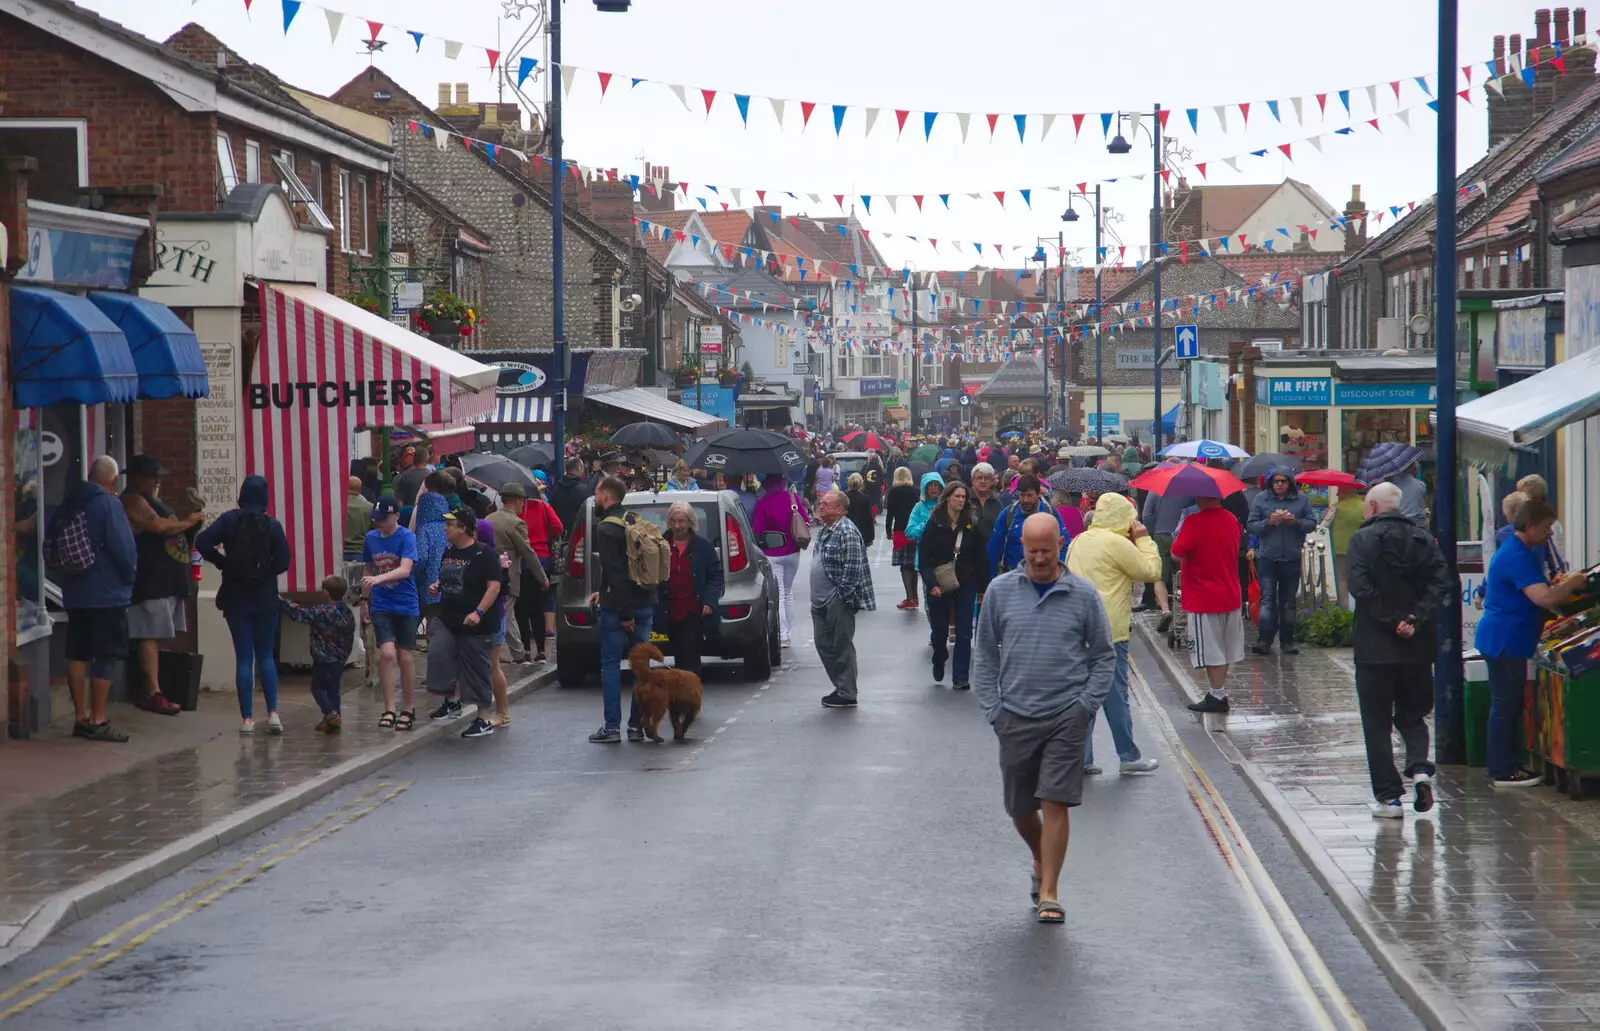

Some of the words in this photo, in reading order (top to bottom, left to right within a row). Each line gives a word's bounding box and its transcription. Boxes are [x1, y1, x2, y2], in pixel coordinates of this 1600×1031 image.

[1119, 354, 1140, 363] THE
[1274, 381, 1292, 392] MR
[250, 378, 435, 410] BUTCHERS
[1341, 390, 1386, 398] DISCOUNT
[1389, 389, 1415, 397] STORE
[201, 415, 231, 423] LOCAL
[201, 424, 229, 433] DAIRY
[199, 433, 235, 442] PRODUCTS
[202, 448, 230, 460] DELI
[203, 467, 231, 475] HOME
[200, 476, 236, 485] COOKED
[203, 485, 231, 494] MEATS
